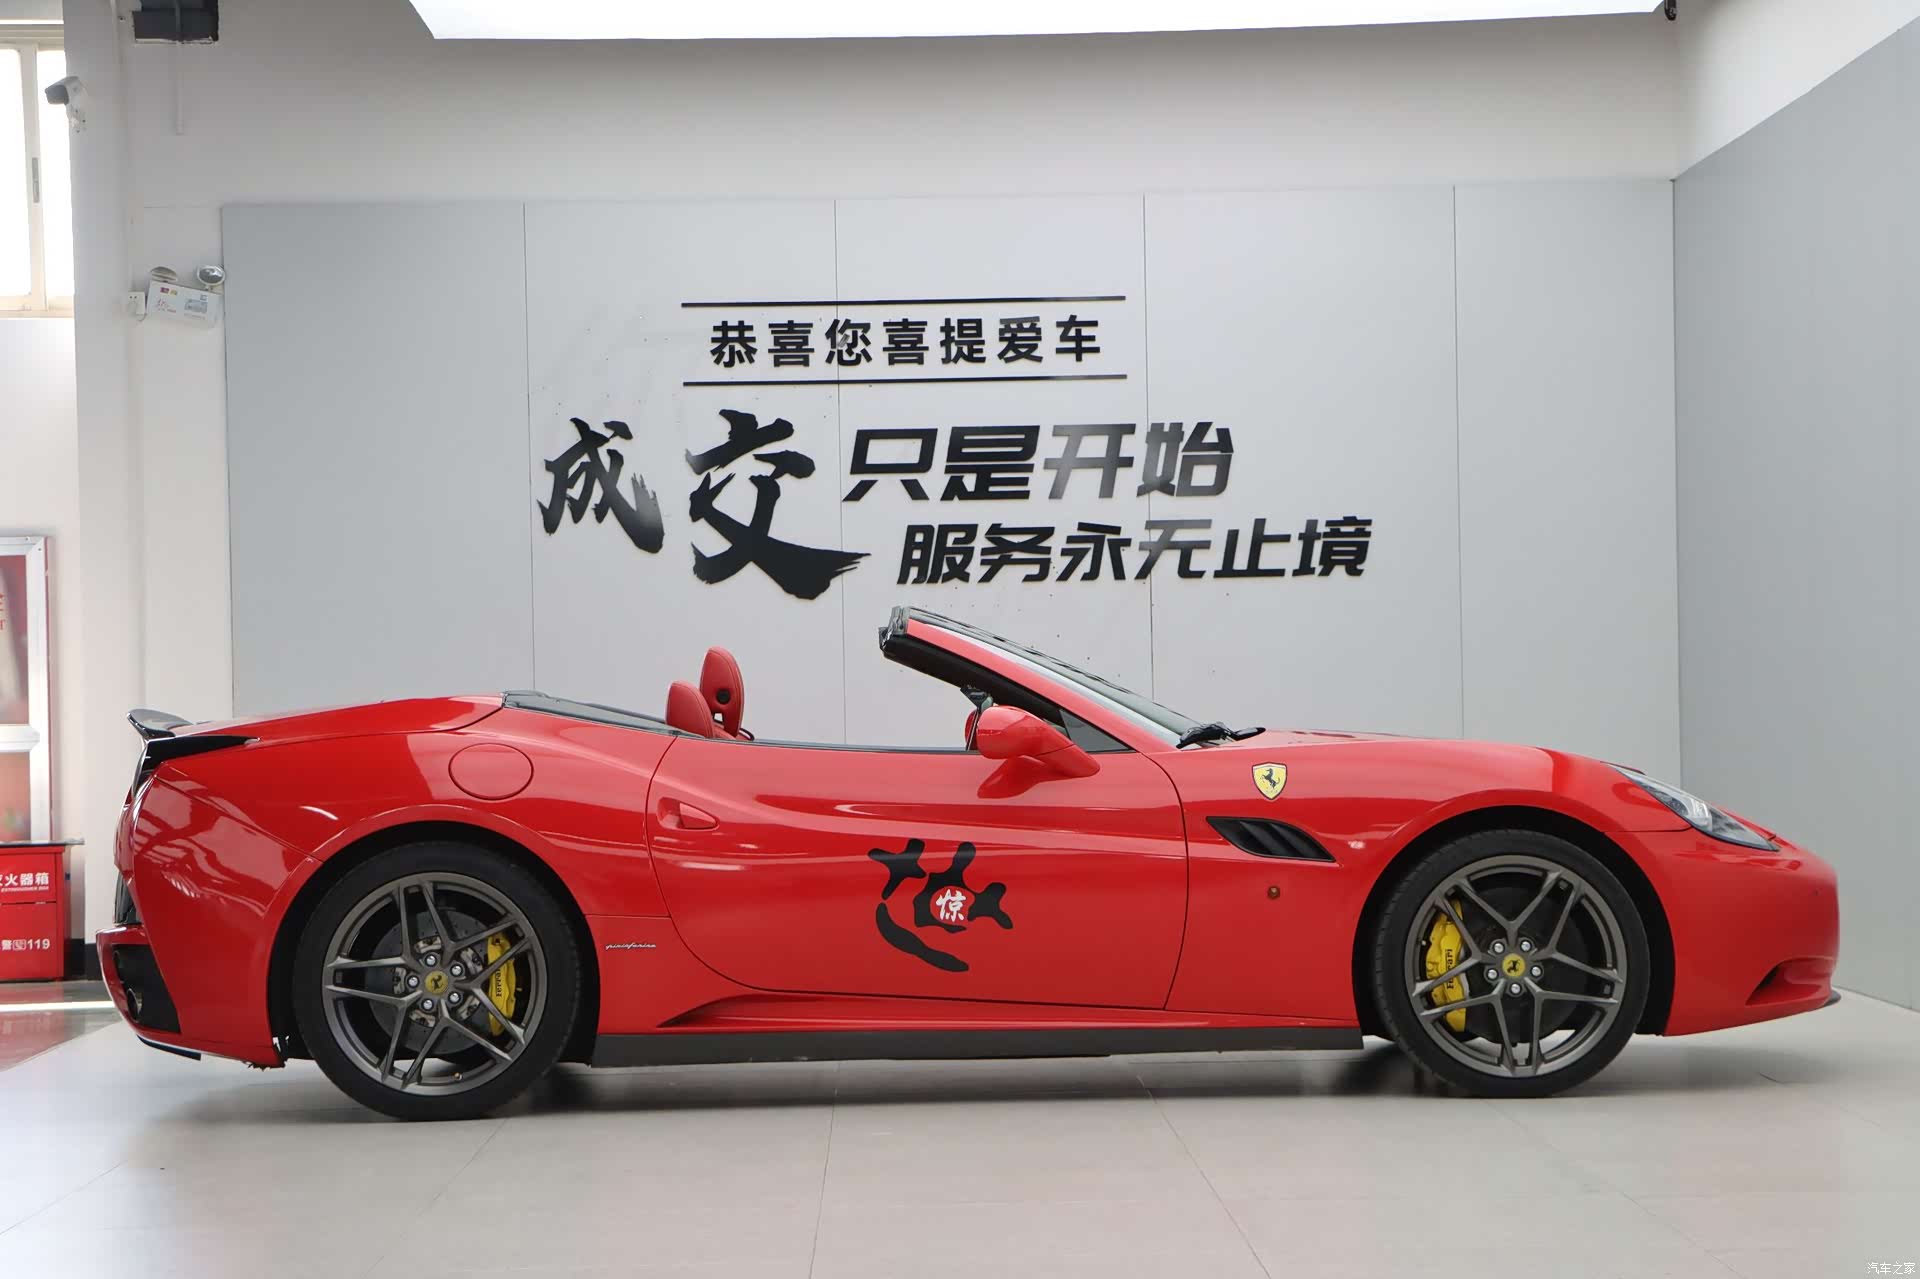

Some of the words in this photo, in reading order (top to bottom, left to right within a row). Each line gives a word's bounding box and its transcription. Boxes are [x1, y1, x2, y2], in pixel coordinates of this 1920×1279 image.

[709, 315, 1102, 369] 恭喜您喜提爱车
[538, 408, 872, 600] 成交
[843, 421, 1235, 503] 只是开始
[897, 515, 1374, 585] 服务永无止境
[0, 872, 49, 887] 火器箱
[935, 888, 967, 922] 惊
